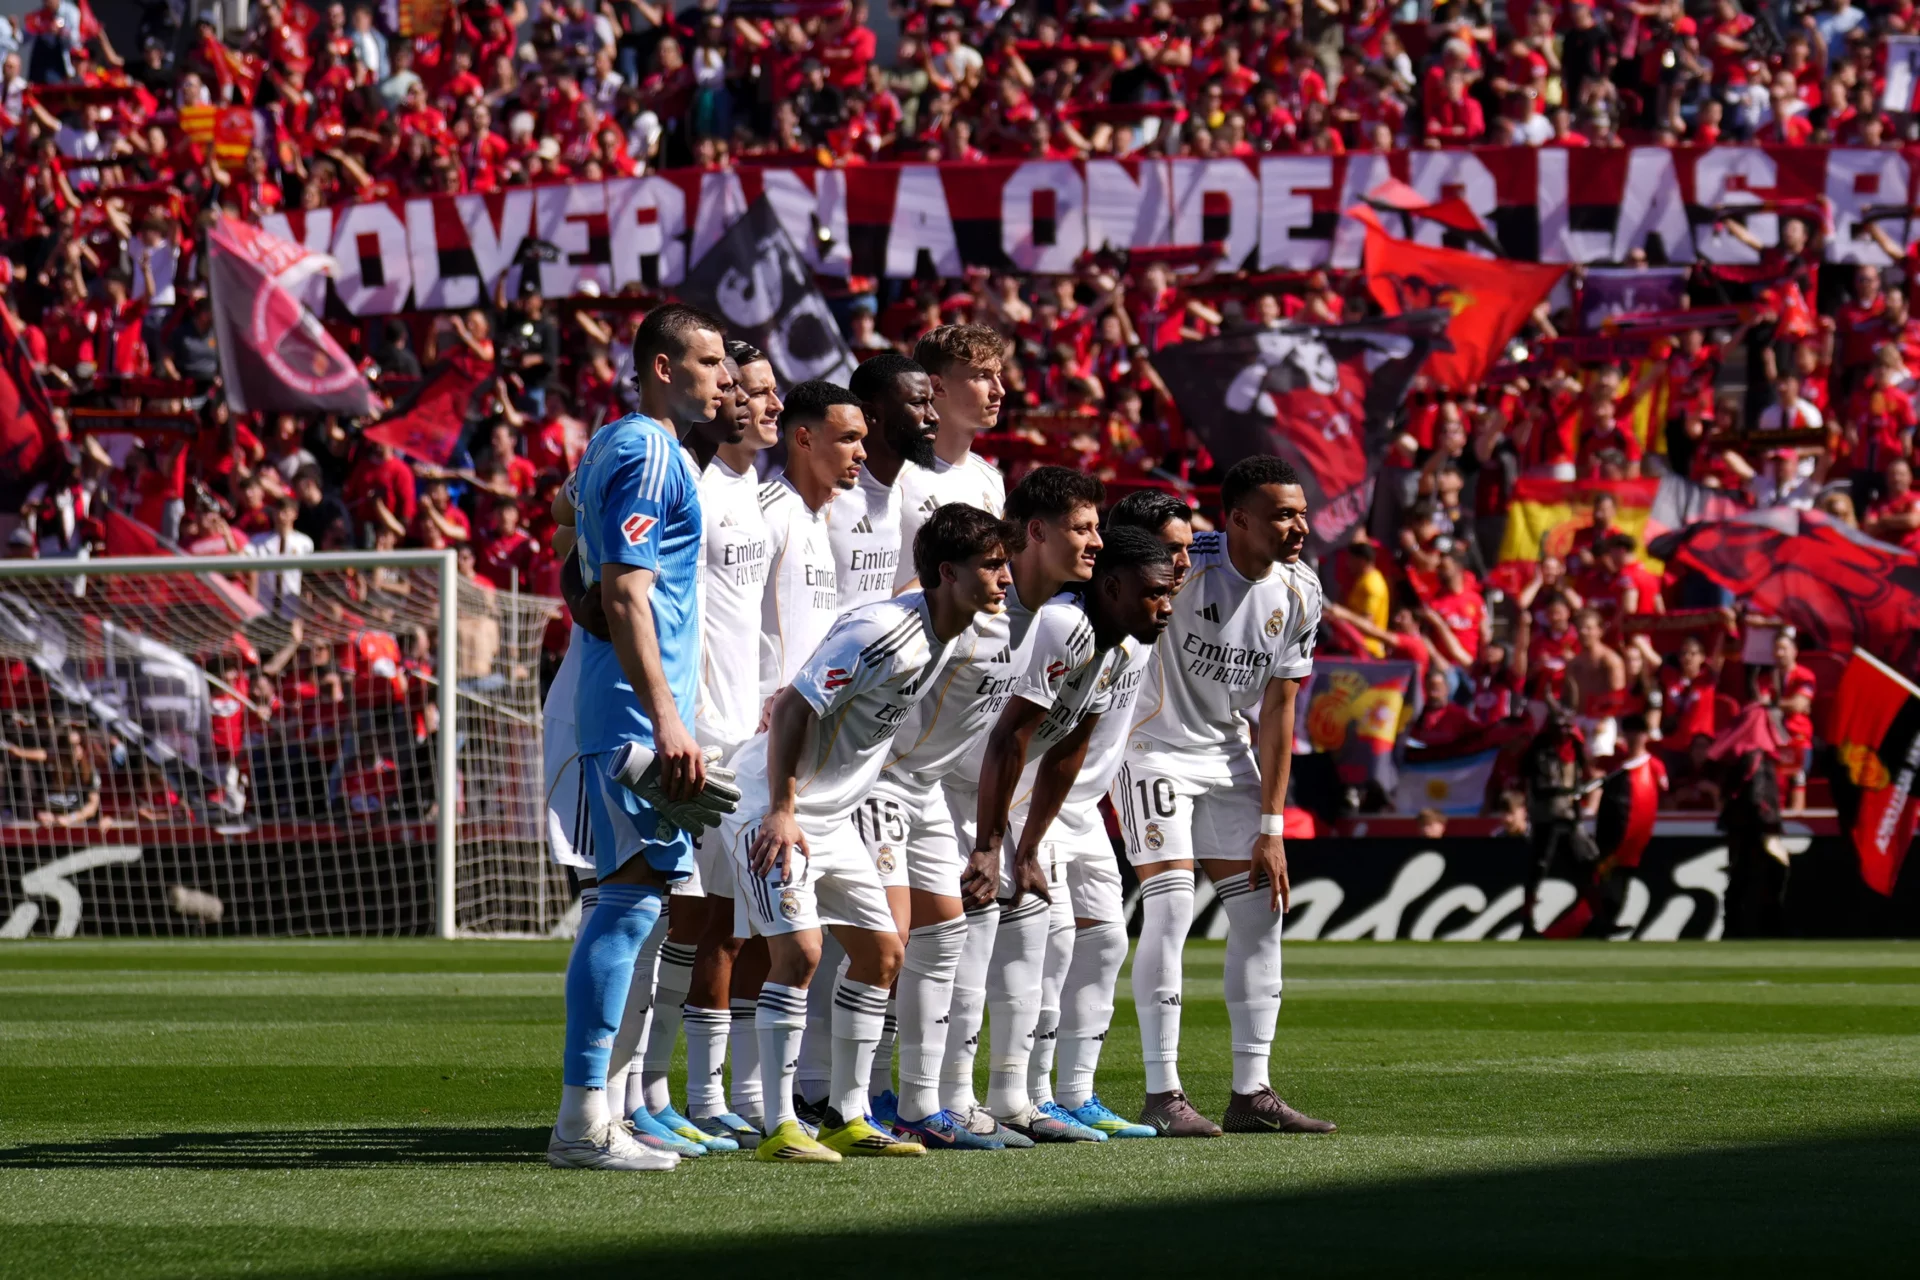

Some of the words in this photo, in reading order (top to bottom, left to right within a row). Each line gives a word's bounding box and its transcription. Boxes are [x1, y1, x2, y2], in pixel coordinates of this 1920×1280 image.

[885, 164, 964, 278] A
[1537, 146, 1781, 264] LAS
[805, 564, 836, 590] Emira
[857, 574, 875, 592] FLY
[1183, 632, 1274, 667] Emirates
[1188, 659, 1215, 678] FLY
[1213, 666, 1255, 686] BETTER
[1136, 778, 1177, 820] 10
[865, 798, 905, 842] 15
